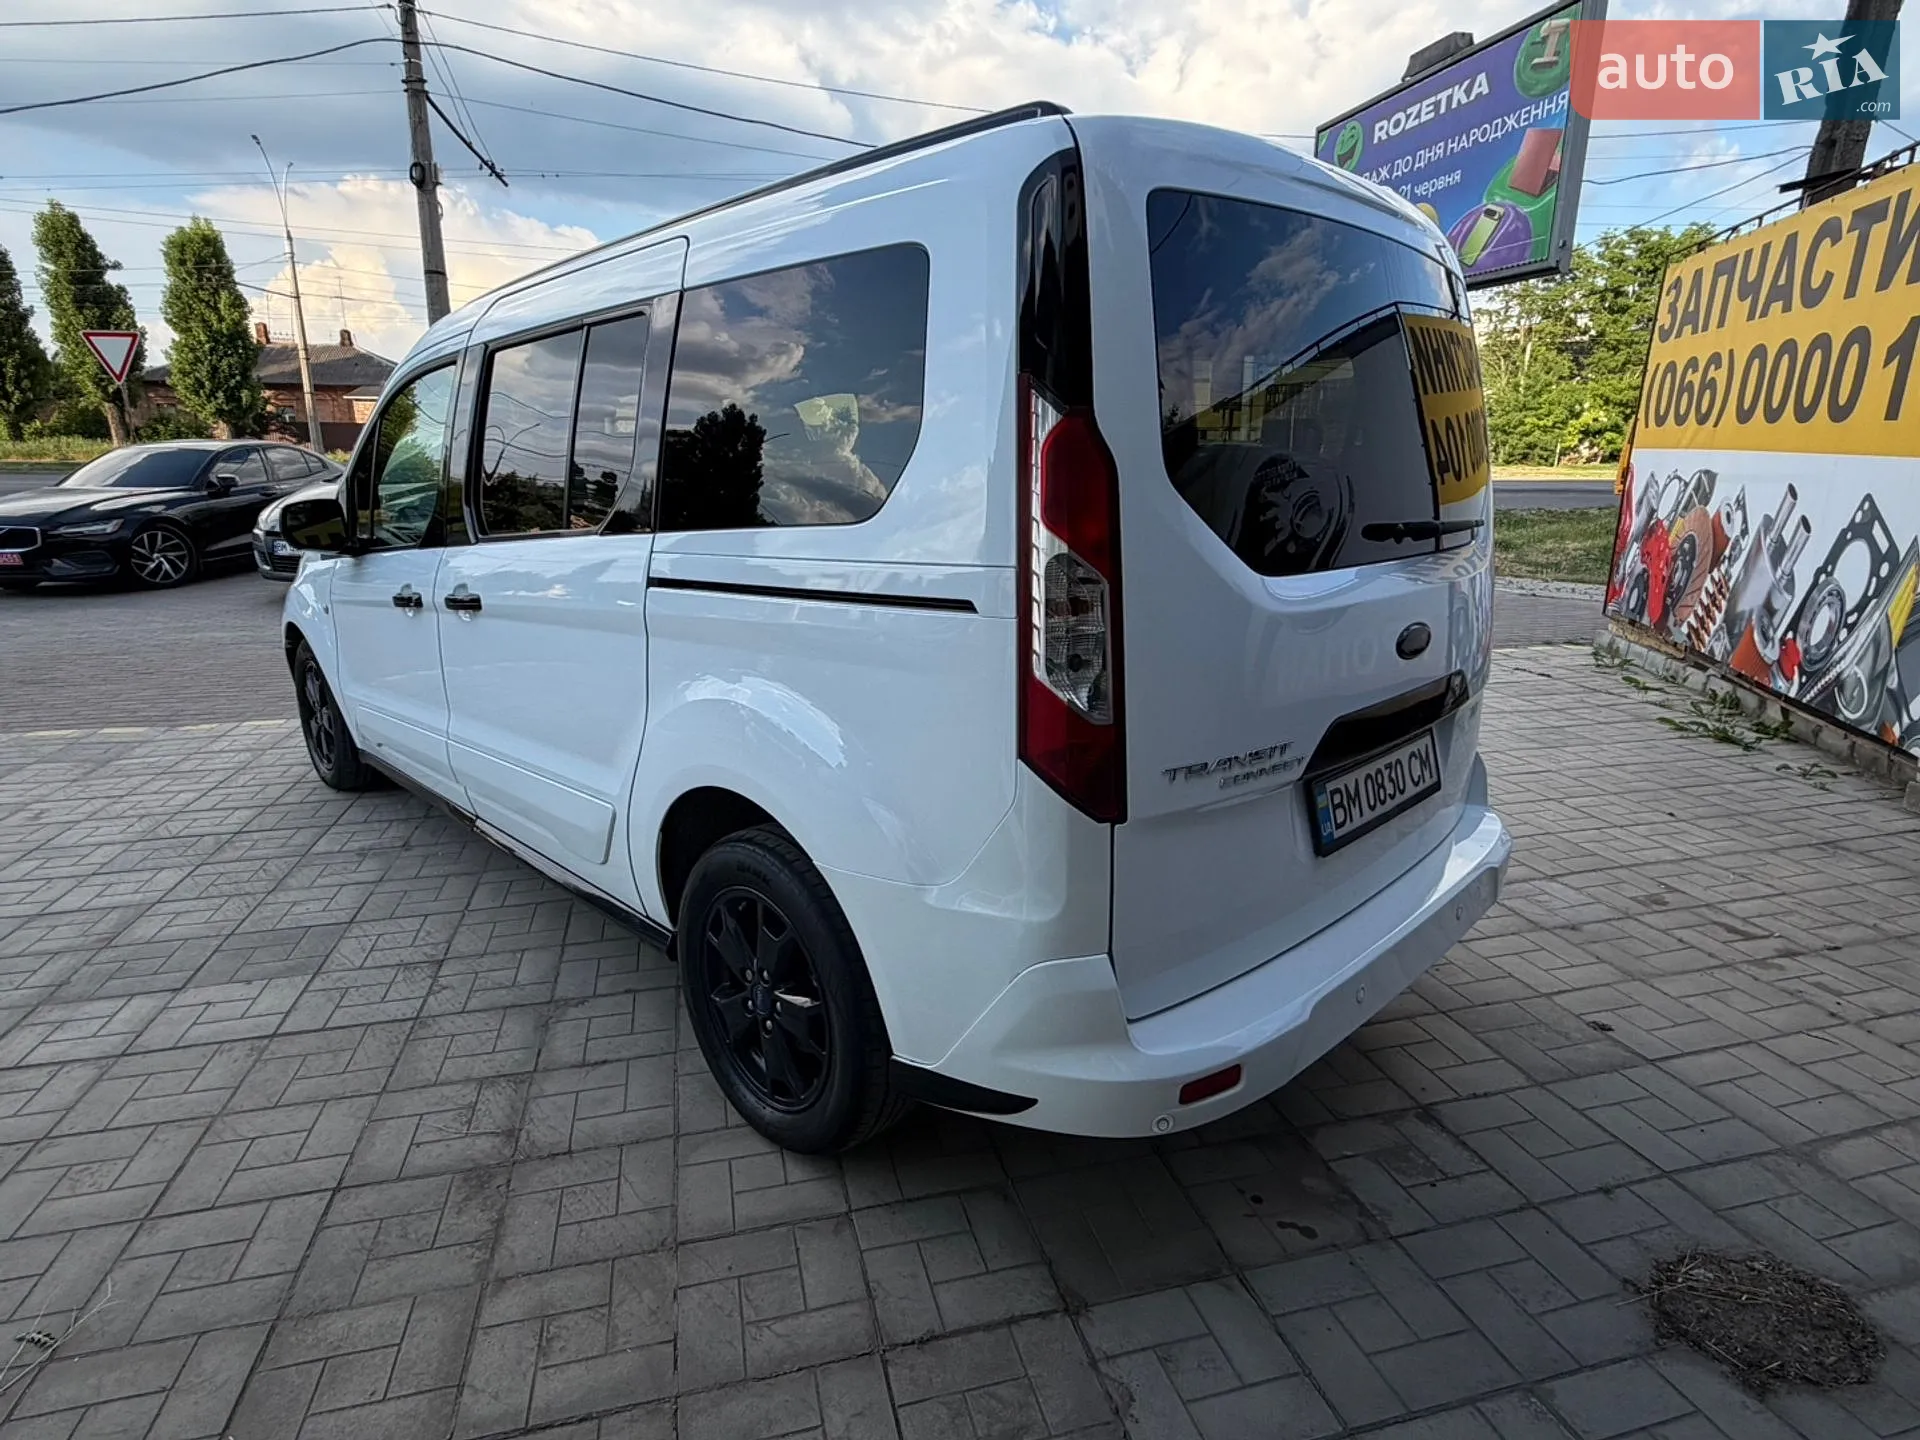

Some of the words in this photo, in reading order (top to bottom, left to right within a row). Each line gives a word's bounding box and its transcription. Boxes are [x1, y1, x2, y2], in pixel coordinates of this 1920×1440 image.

[1372, 71, 1490, 144] ROZETKA
[1391, 155, 1413, 180] ДО
[1413, 140, 1445, 171] ДНЯ
[1446, 90, 1569, 157] НАРОДЖЕННЯ
[1414, 169, 1462, 198] червня
[1657, 188, 1920, 344] ЗАПЧАСТИ
[1329, 778, 1363, 830] BM
[1364, 758, 1406, 812] 0830
[1408, 743, 1433, 787] CM
